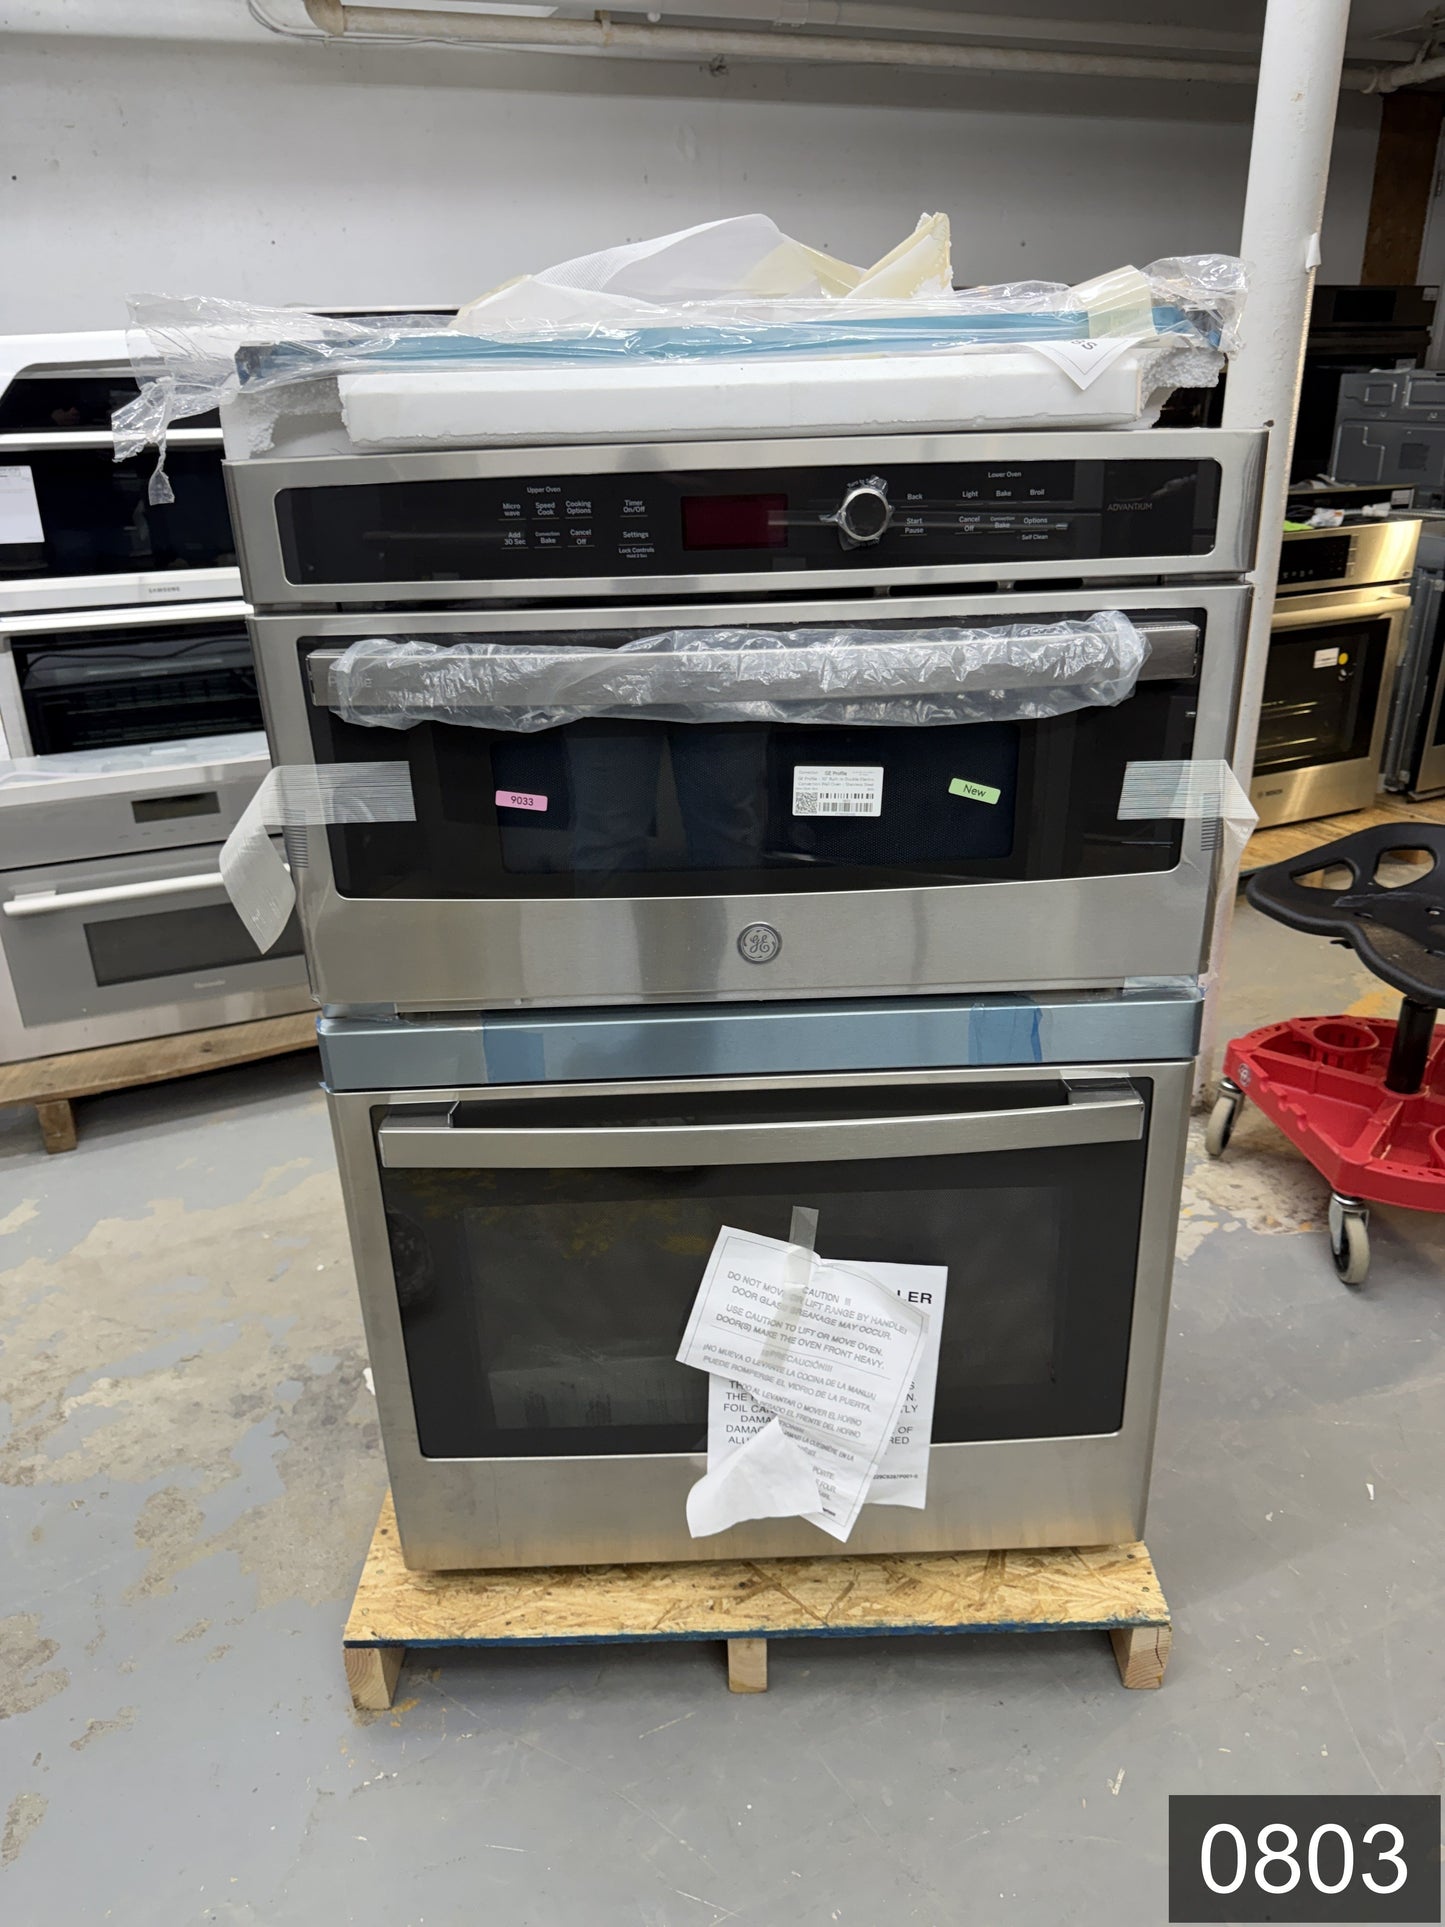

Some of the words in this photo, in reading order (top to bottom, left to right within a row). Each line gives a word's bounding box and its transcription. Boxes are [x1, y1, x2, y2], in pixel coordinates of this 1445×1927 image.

[962, 490, 978, 498] Light
[1107, 502, 1153, 511] ADVANTIUM
[623, 531, 649, 539] Settings
[963, 784, 987, 797] New
[511, 796, 534, 806] 9033
[727, 1271, 741, 1281] DO
[742, 1276, 761, 1289] NOT
[805, 1299, 824, 1310] LIFT
[824, 1305, 856, 1319] RANGE
[857, 1312, 870, 1322] BY
[802, 1286, 840, 1303] CAUTION
[732, 1285, 759, 1301] DOOR
[838, 1321, 858, 1331] MAY
[859, 1325, 892, 1340] OCCUR.
[726, 1304, 744, 1316] USE
[745, 1310, 783, 1328] CAUTION
[785, 1323, 797, 1332] TO
[798, 1325, 816, 1337] LIFT
[816, 1332, 830, 1340] OR
[831, 1335, 857, 1348] MOVE
[857, 1342, 883, 1357] OVEN.
[716, 1313, 752, 1332] DOOR(S)
[753, 1327, 778, 1339] MAKE
[779, 1333, 797, 1344] THE
[797, 1339, 822, 1351] OVEN
[823, 1344, 853, 1359] FRONT
[853, 1353, 885, 1369] HEAVY.
[718, 1346, 744, 1361] MUEVA
[785, 1368, 795, 1377] LA
[797, 1371, 825, 1385] COCINA
[825, 1378, 837, 1387] DE
[837, 1381, 846, 1390] LA
[703, 1355, 731, 1368] PUEDE
[776, 1378, 785, 1388] EL
[788, 1382, 814, 1396] VIDRIO
[815, 1390, 827, 1398] DE
[827, 1393, 838, 1402] LA
[725, 1392, 748, 1402] THE
[723, 1403, 748, 1413] FOIL
[761, 1390, 797, 1408] LEVANTAR
[803, 1404, 828, 1417] MOVER
[828, 1411, 836, 1420] EL
[837, 1412, 863, 1427] HORNO
[786, 1409, 795, 1418] EL
[822, 1421, 836, 1432] DEL
[836, 1426, 862, 1439] HORNO
[897, 1426, 913, 1434] OF
